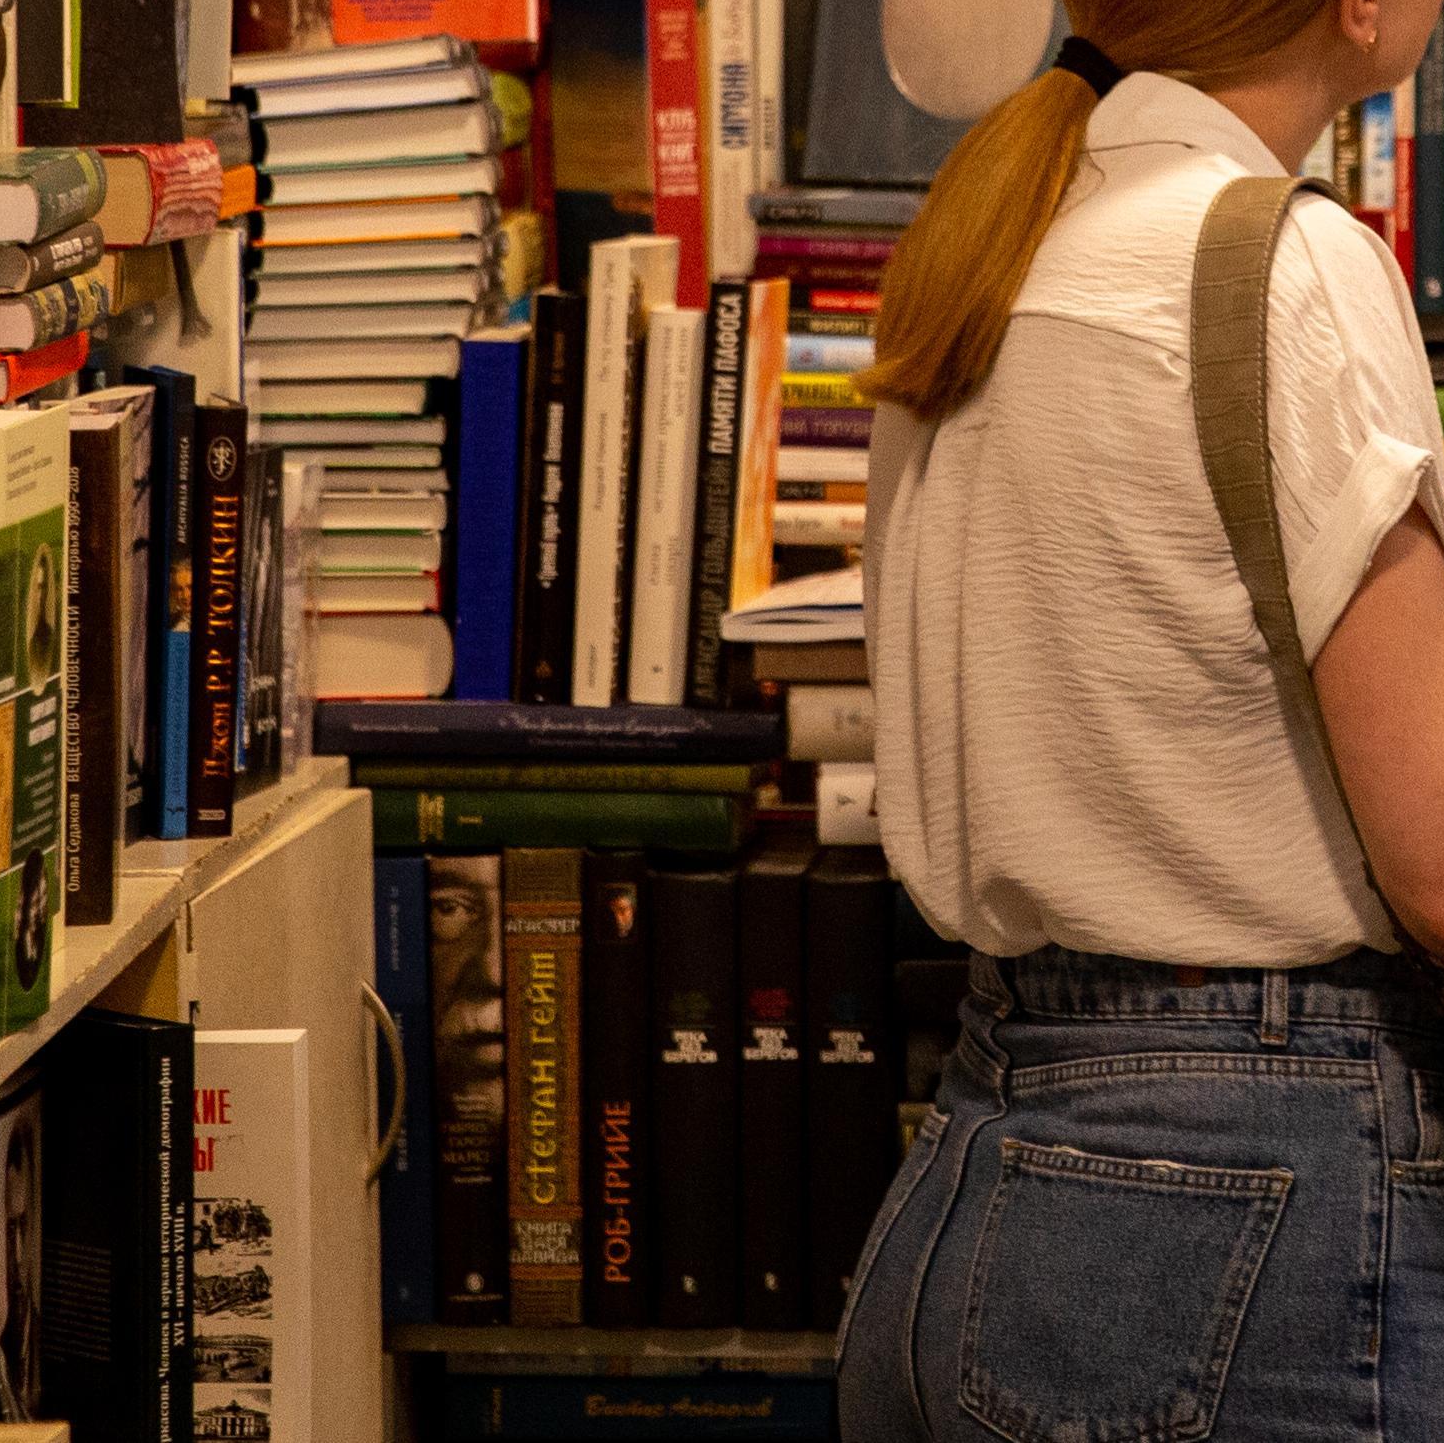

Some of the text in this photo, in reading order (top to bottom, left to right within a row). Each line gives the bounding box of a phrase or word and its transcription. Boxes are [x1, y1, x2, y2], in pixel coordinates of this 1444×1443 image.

[711, 293, 744, 372] ПАФОСА
[707, 374, 738, 455] ПАМЯТИ
[65, 530, 85, 595] Интервью
[206, 493, 239, 636] ТОЛКИН
[64, 605, 82, 710] ЧЕЛОВЕЧНОСТИ
[64, 712, 83, 783] ВЕЩЕСТВО
[203, 701, 232, 780] Джон
[66, 792, 83, 853] Седакова
[66, 856, 83, 892] Ольга
[158, 1057, 176, 1150] демографии
[158, 1151, 175, 1255] исторической
[602, 1100, 633, 1284] РОБ-ГРИЙЕ
[175, 1255, 186, 1308] начало
[157, 1321, 172, 1378] Человек
